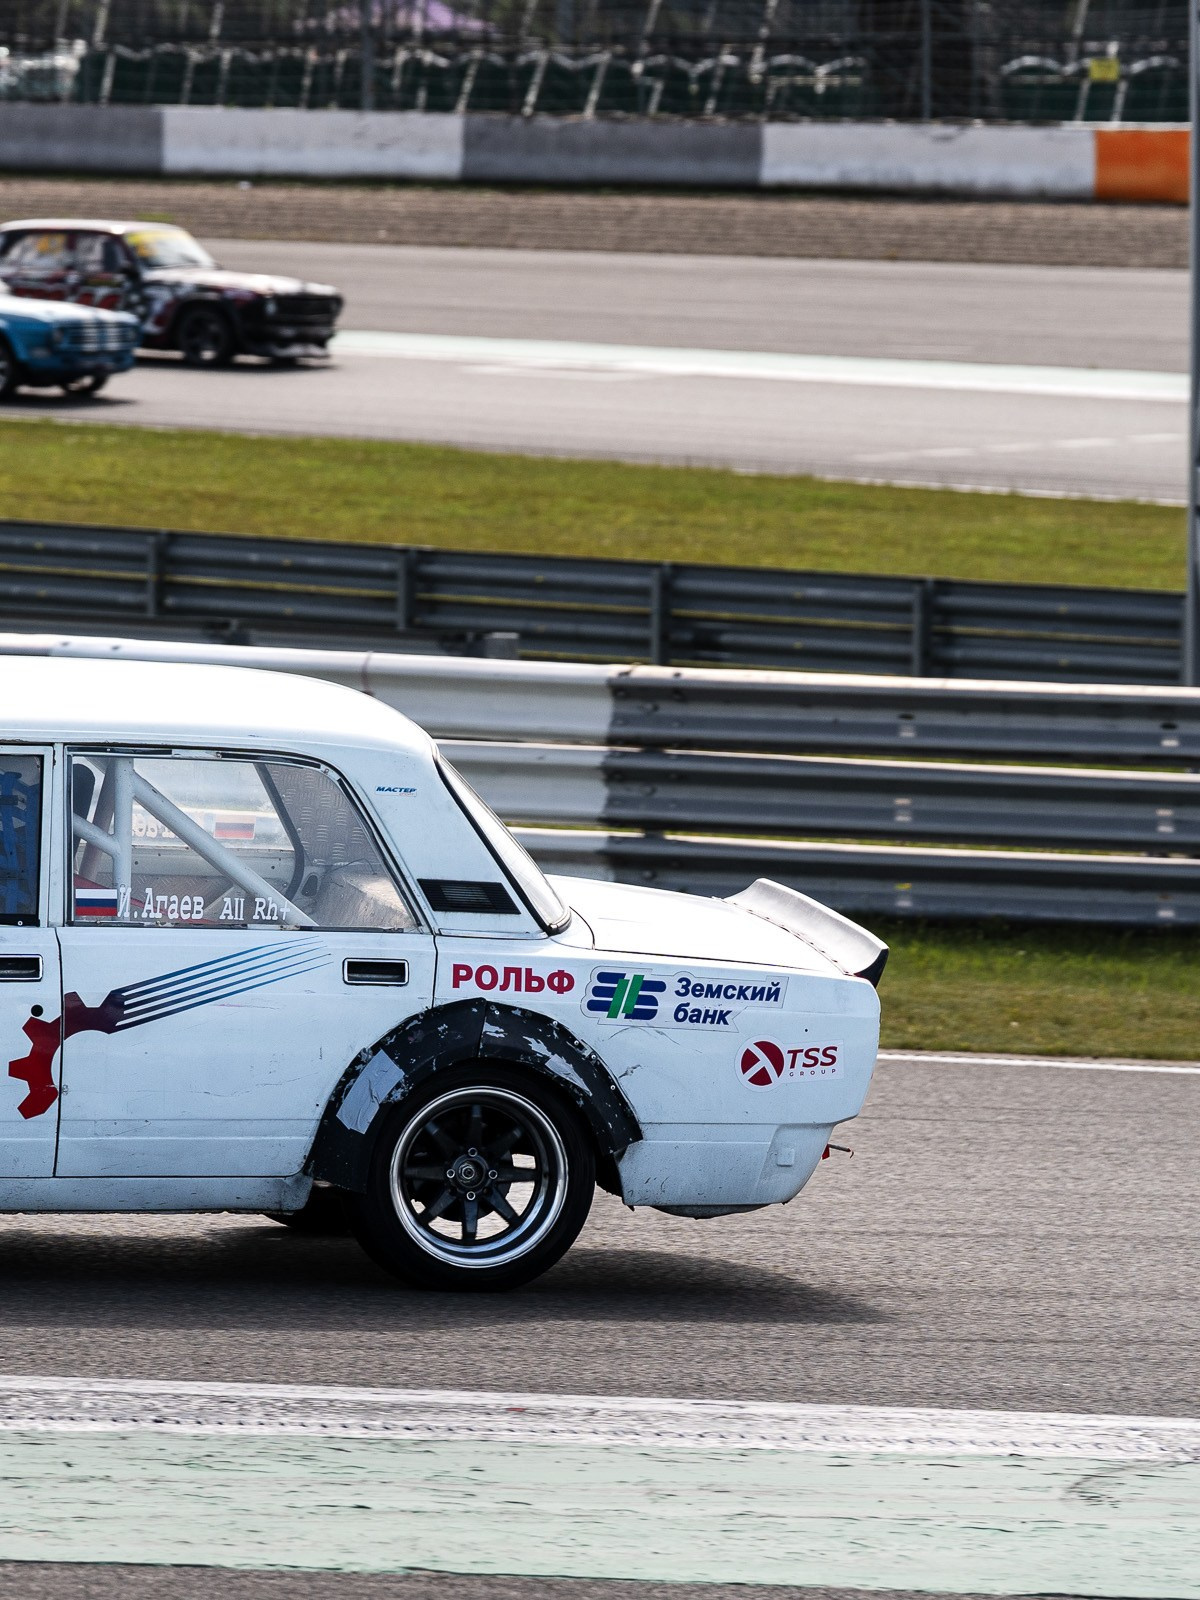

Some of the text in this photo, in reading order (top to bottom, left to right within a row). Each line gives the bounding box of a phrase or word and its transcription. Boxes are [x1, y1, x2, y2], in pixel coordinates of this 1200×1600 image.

[252, 896, 291, 921] Rh+
[452, 963, 575, 995] РОЛЬФ
[674, 976, 782, 1003] Земский
[673, 1002, 733, 1026] банк
[786, 1046, 838, 1070] TSS
[789, 1068, 837, 1077] GROUP
